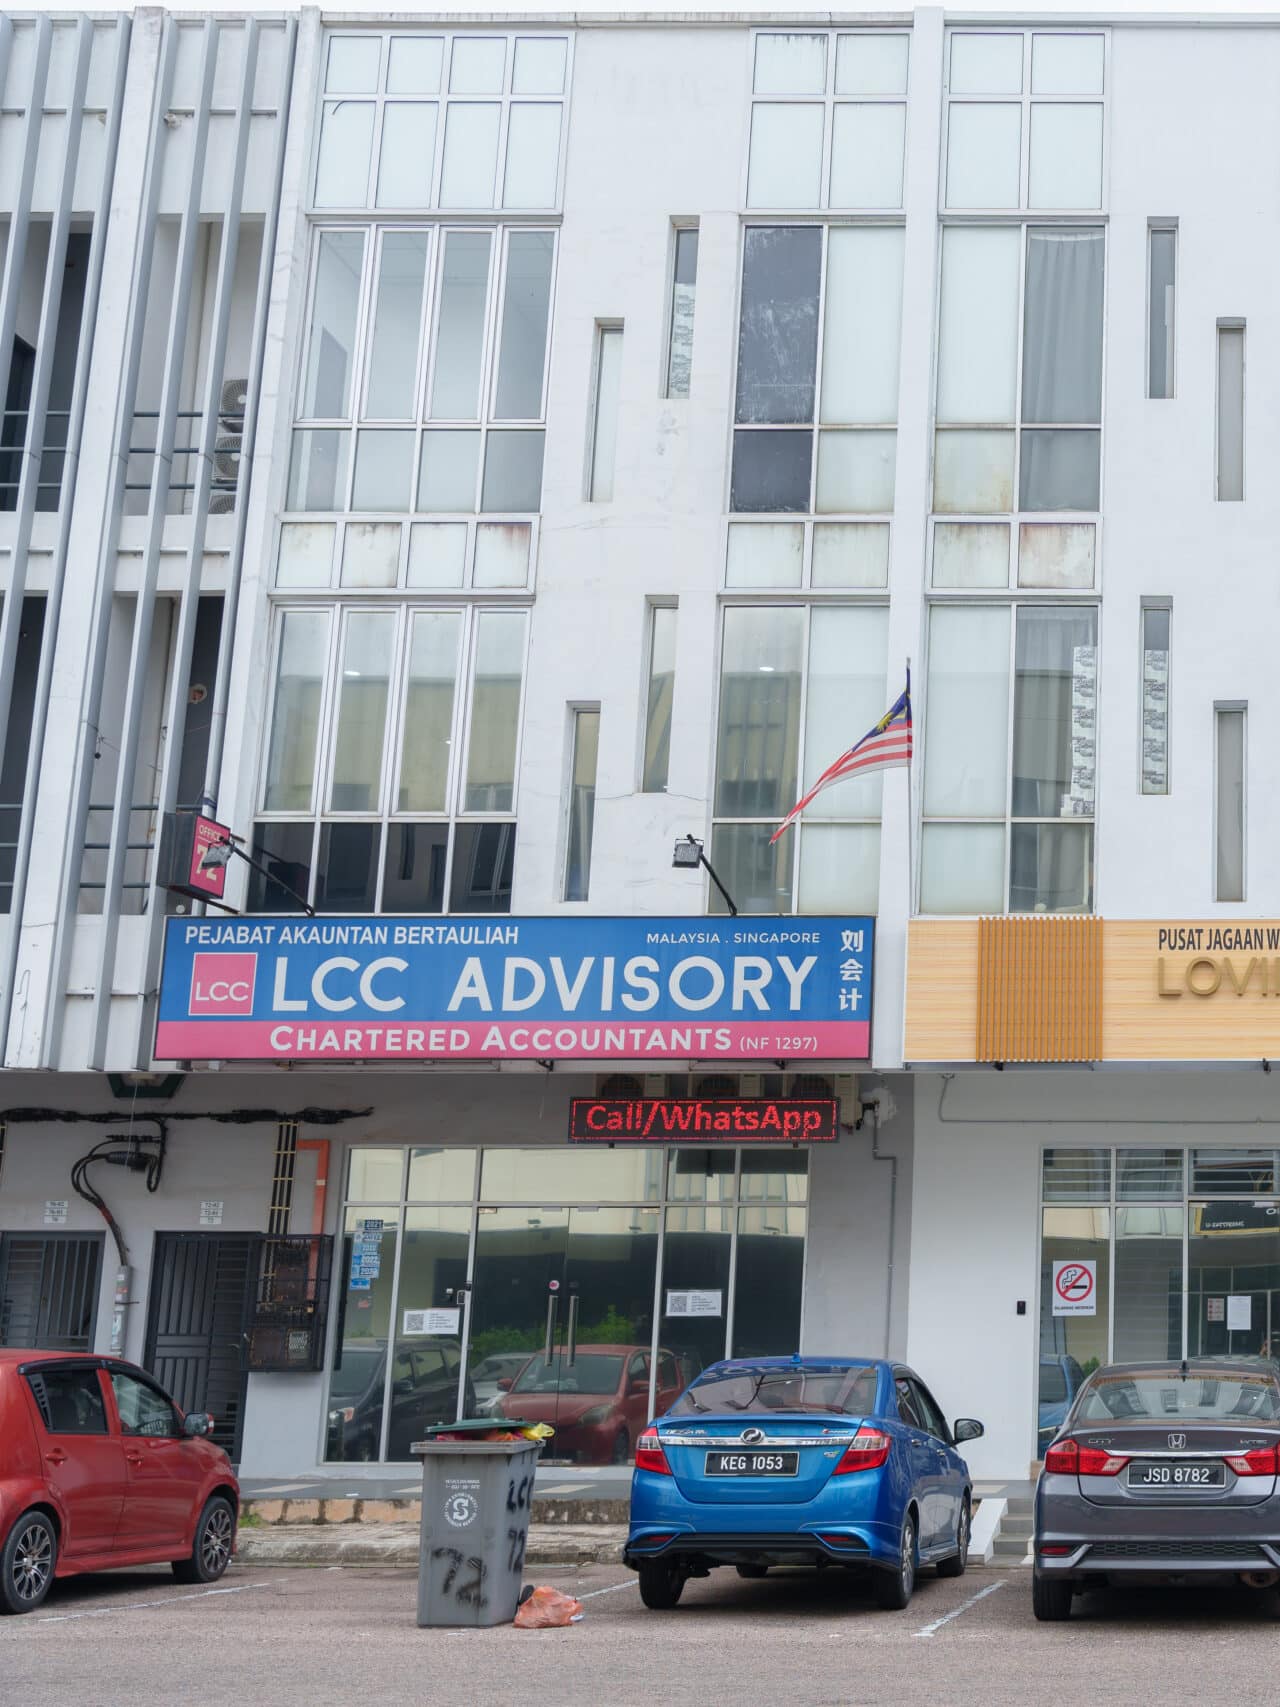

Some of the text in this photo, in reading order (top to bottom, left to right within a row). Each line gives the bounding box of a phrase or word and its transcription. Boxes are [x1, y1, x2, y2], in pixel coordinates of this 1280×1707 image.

[186, 926, 518, 944] PEJABAT AKAUNTAN BERTAULIAH
[647, 933, 819, 943] MALAYSIA SINGAPORE
[1159, 929, 1203, 950] PUSAT
[1206, 928, 1265, 950] JAGAAN
[839, 930, 864, 1011] 刘会计
[195, 981, 249, 1000] LCC
[272, 956, 818, 1012] LCC ADVISORY
[270, 1026, 817, 1051] CHARTERED ACCOUNTANTS (NF 1297)
[586, 1101, 822, 1137] Call/WhatsApp
[720, 1456, 783, 1470] KEG 1053
[1144, 1468, 1209, 1482] JSD 8782
[432, 1548, 487, 1607] 72
